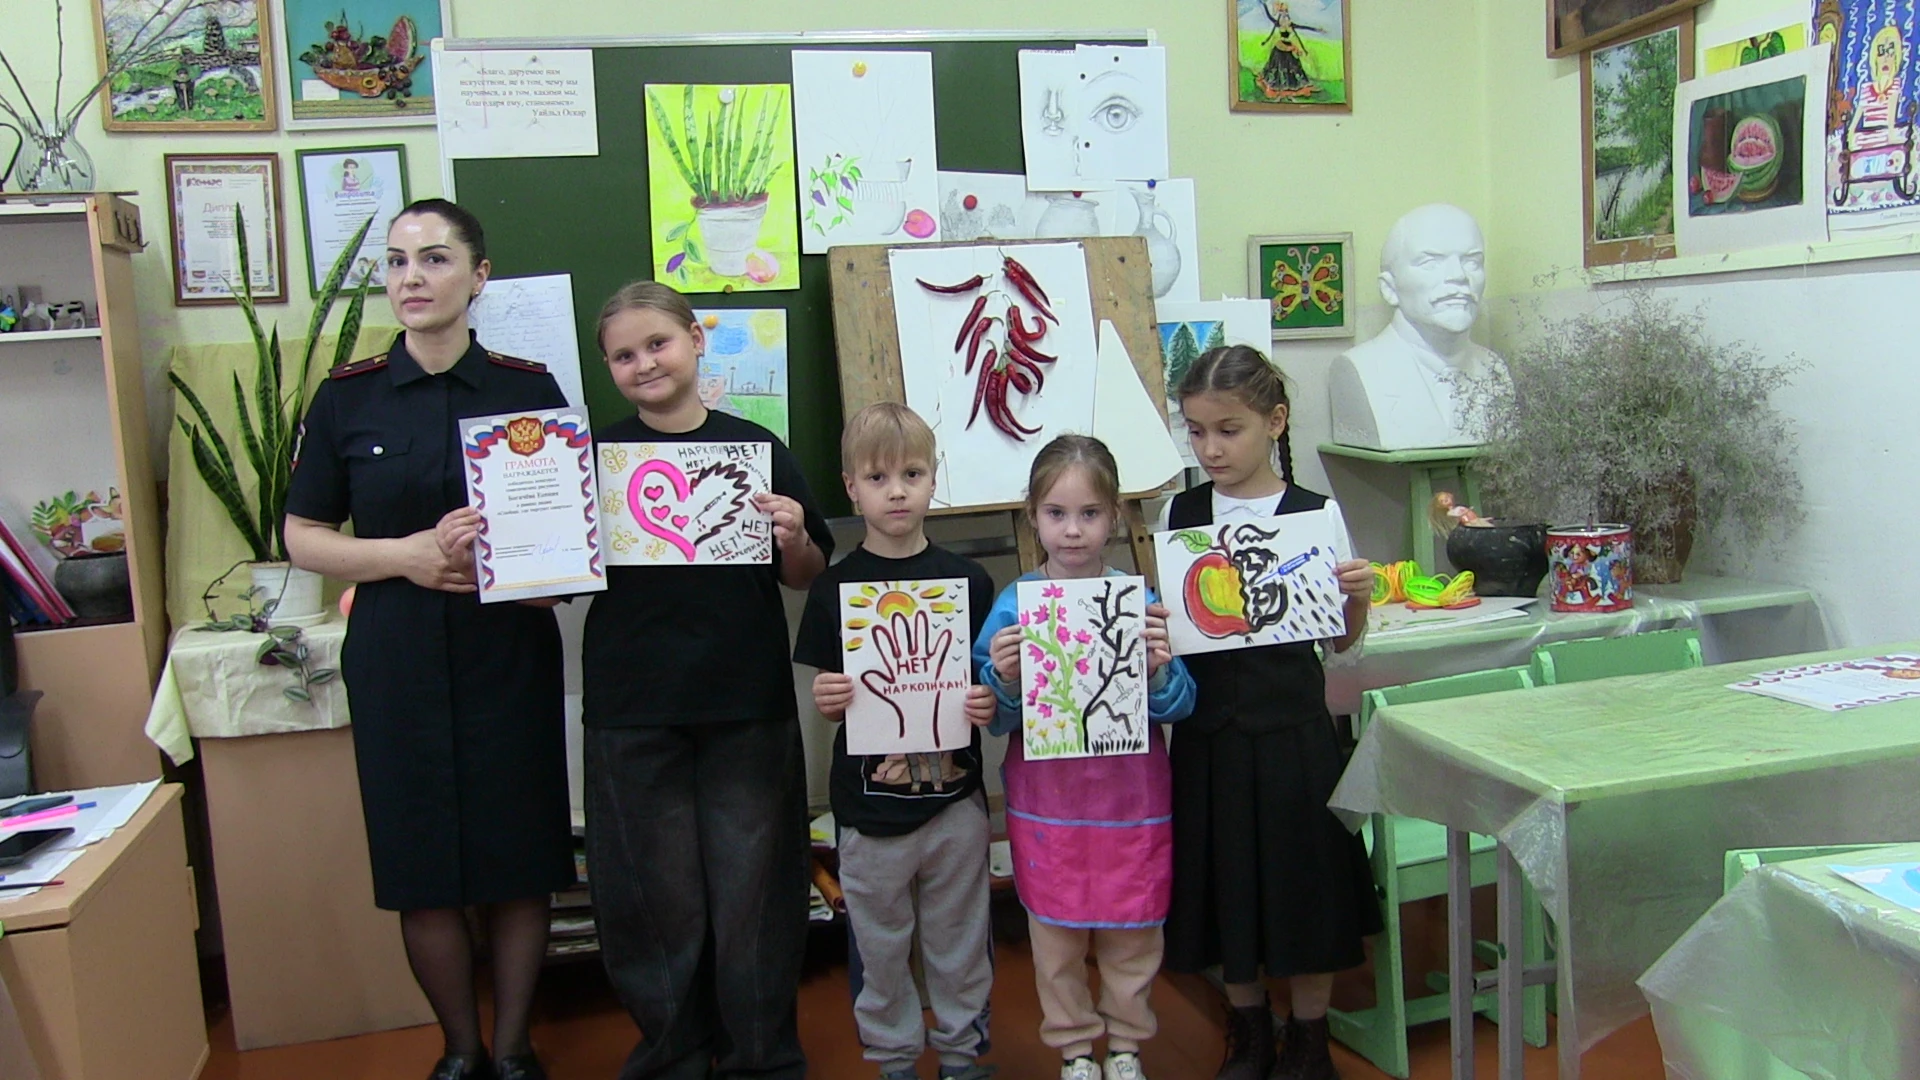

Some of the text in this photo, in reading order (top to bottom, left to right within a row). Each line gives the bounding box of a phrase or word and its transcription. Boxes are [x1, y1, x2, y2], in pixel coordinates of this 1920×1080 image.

[562, 108, 587, 118] Оскар
[726, 443, 765, 460] НЕТ!
[505, 456, 557, 471] ГРАМОТА
[685, 456, 711, 469] НЕТ!
[502, 467, 559, 479] НАГРАЖДАЕТСЯ
[708, 530, 742, 558] НЕТ!
[896, 656, 931, 676] НЕТ
